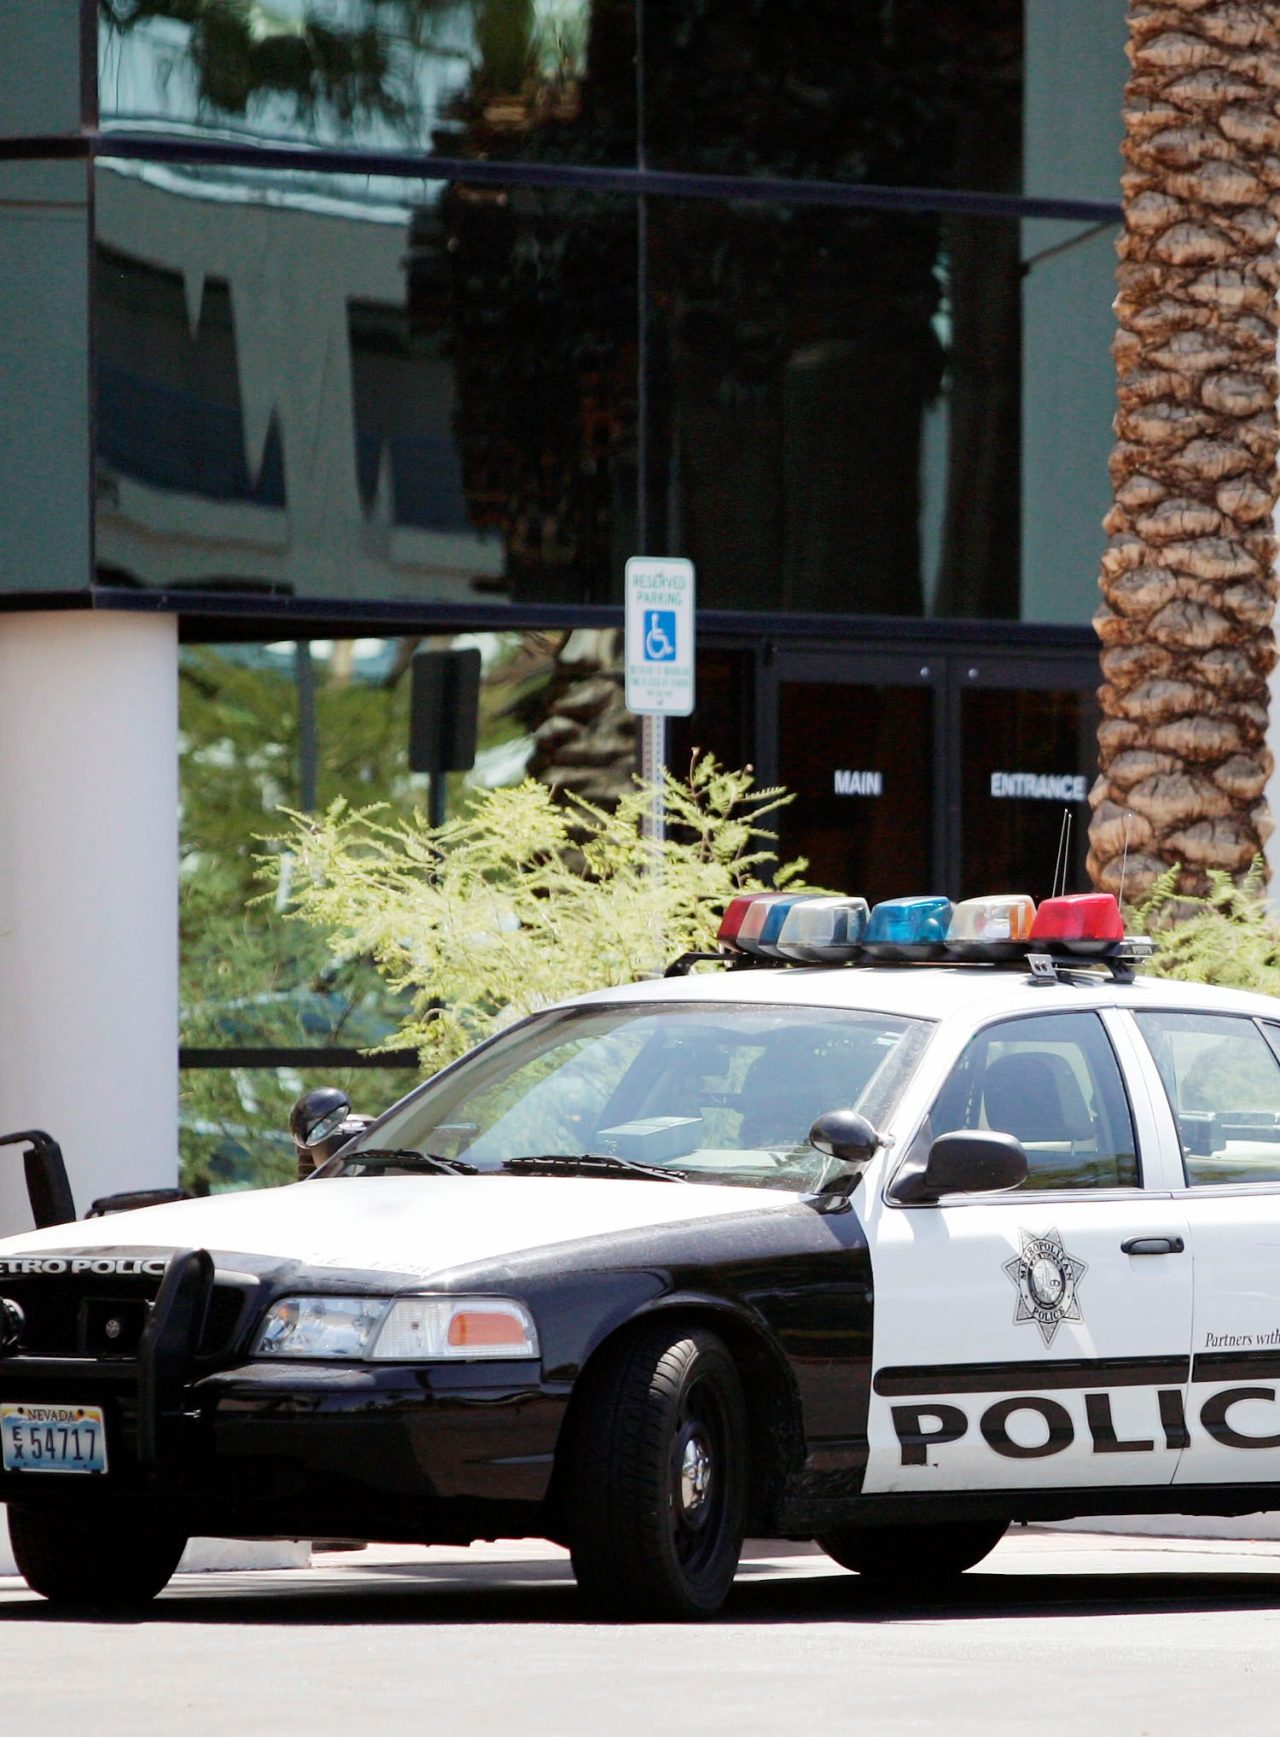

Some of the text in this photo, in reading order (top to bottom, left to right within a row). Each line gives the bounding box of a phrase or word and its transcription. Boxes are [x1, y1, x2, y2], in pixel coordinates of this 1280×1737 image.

[632, 575, 686, 590] RESERVED
[636, 591, 682, 606] PARKING
[834, 770, 1087, 800] MAIN ENTRANCE
[71, 1260, 170, 1275] POLIC
[1020, 1241, 1073, 1280] METROPOLITAN
[1033, 1306, 1065, 1321] POLICE
[1205, 1332, 1252, 1347] Partners
[27, 1409, 75, 1421] NEVADA
[30, 1427, 95, 1460] 54717
